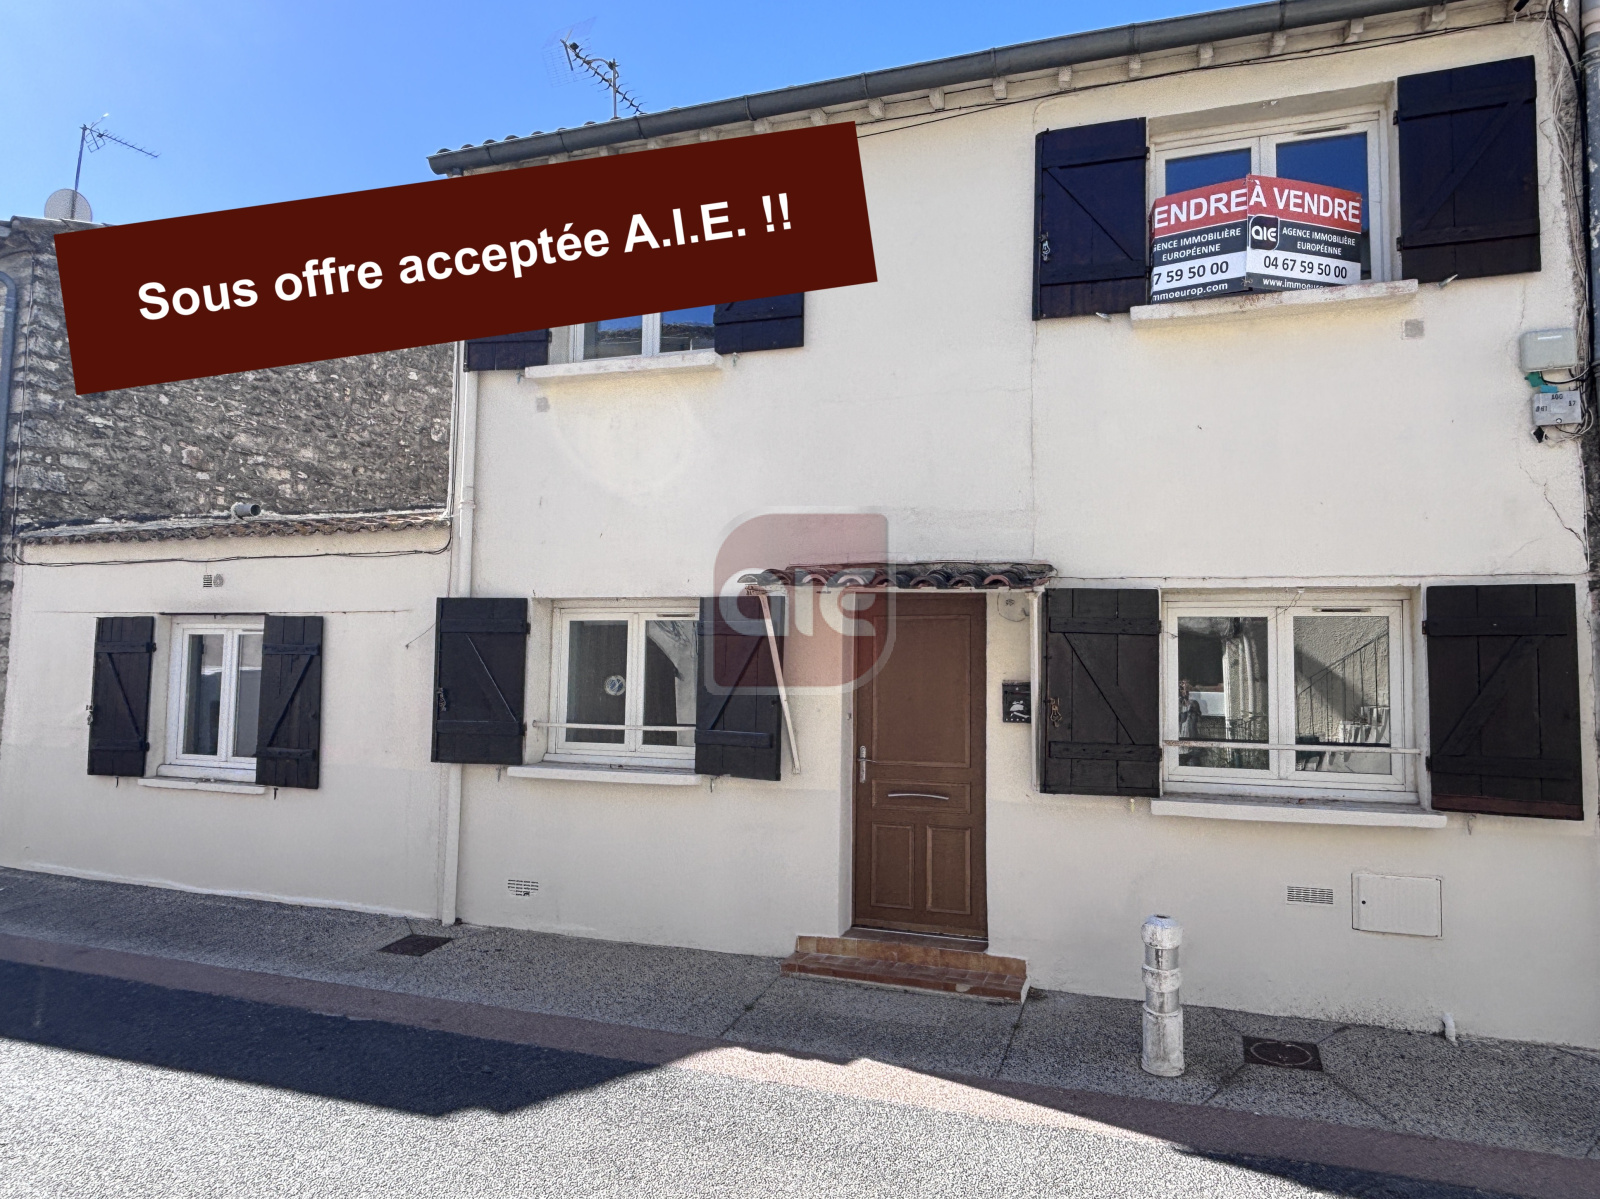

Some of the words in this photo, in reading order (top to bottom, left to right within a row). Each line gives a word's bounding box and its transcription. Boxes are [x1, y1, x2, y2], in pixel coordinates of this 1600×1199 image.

[1154, 188, 1247, 229] ENDRE
[1249, 179, 1267, 208] À
[1273, 187, 1360, 224] VENDRE
[1180, 227, 1242, 247] IMMOBILIÈRE
[1282, 226, 1311, 239] AGENCE
[1311, 231, 1356, 247] IMMOBILIÈRE
[1162, 243, 1221, 262] EUROPÉENNE
[1297, 241, 1342, 256] EUROPÉENNE
[1154, 273, 1162, 286] 7
[1166, 268, 1183, 284] 59
[1188, 264, 1206, 279] 50
[1210, 260, 1229, 275] 00
[1263, 255, 1279, 270] 04
[1282, 257, 1297, 272] 67
[1300, 260, 1314, 274] 59
[1317, 262, 1331, 276] 50
[1334, 265, 1347, 279] 00
